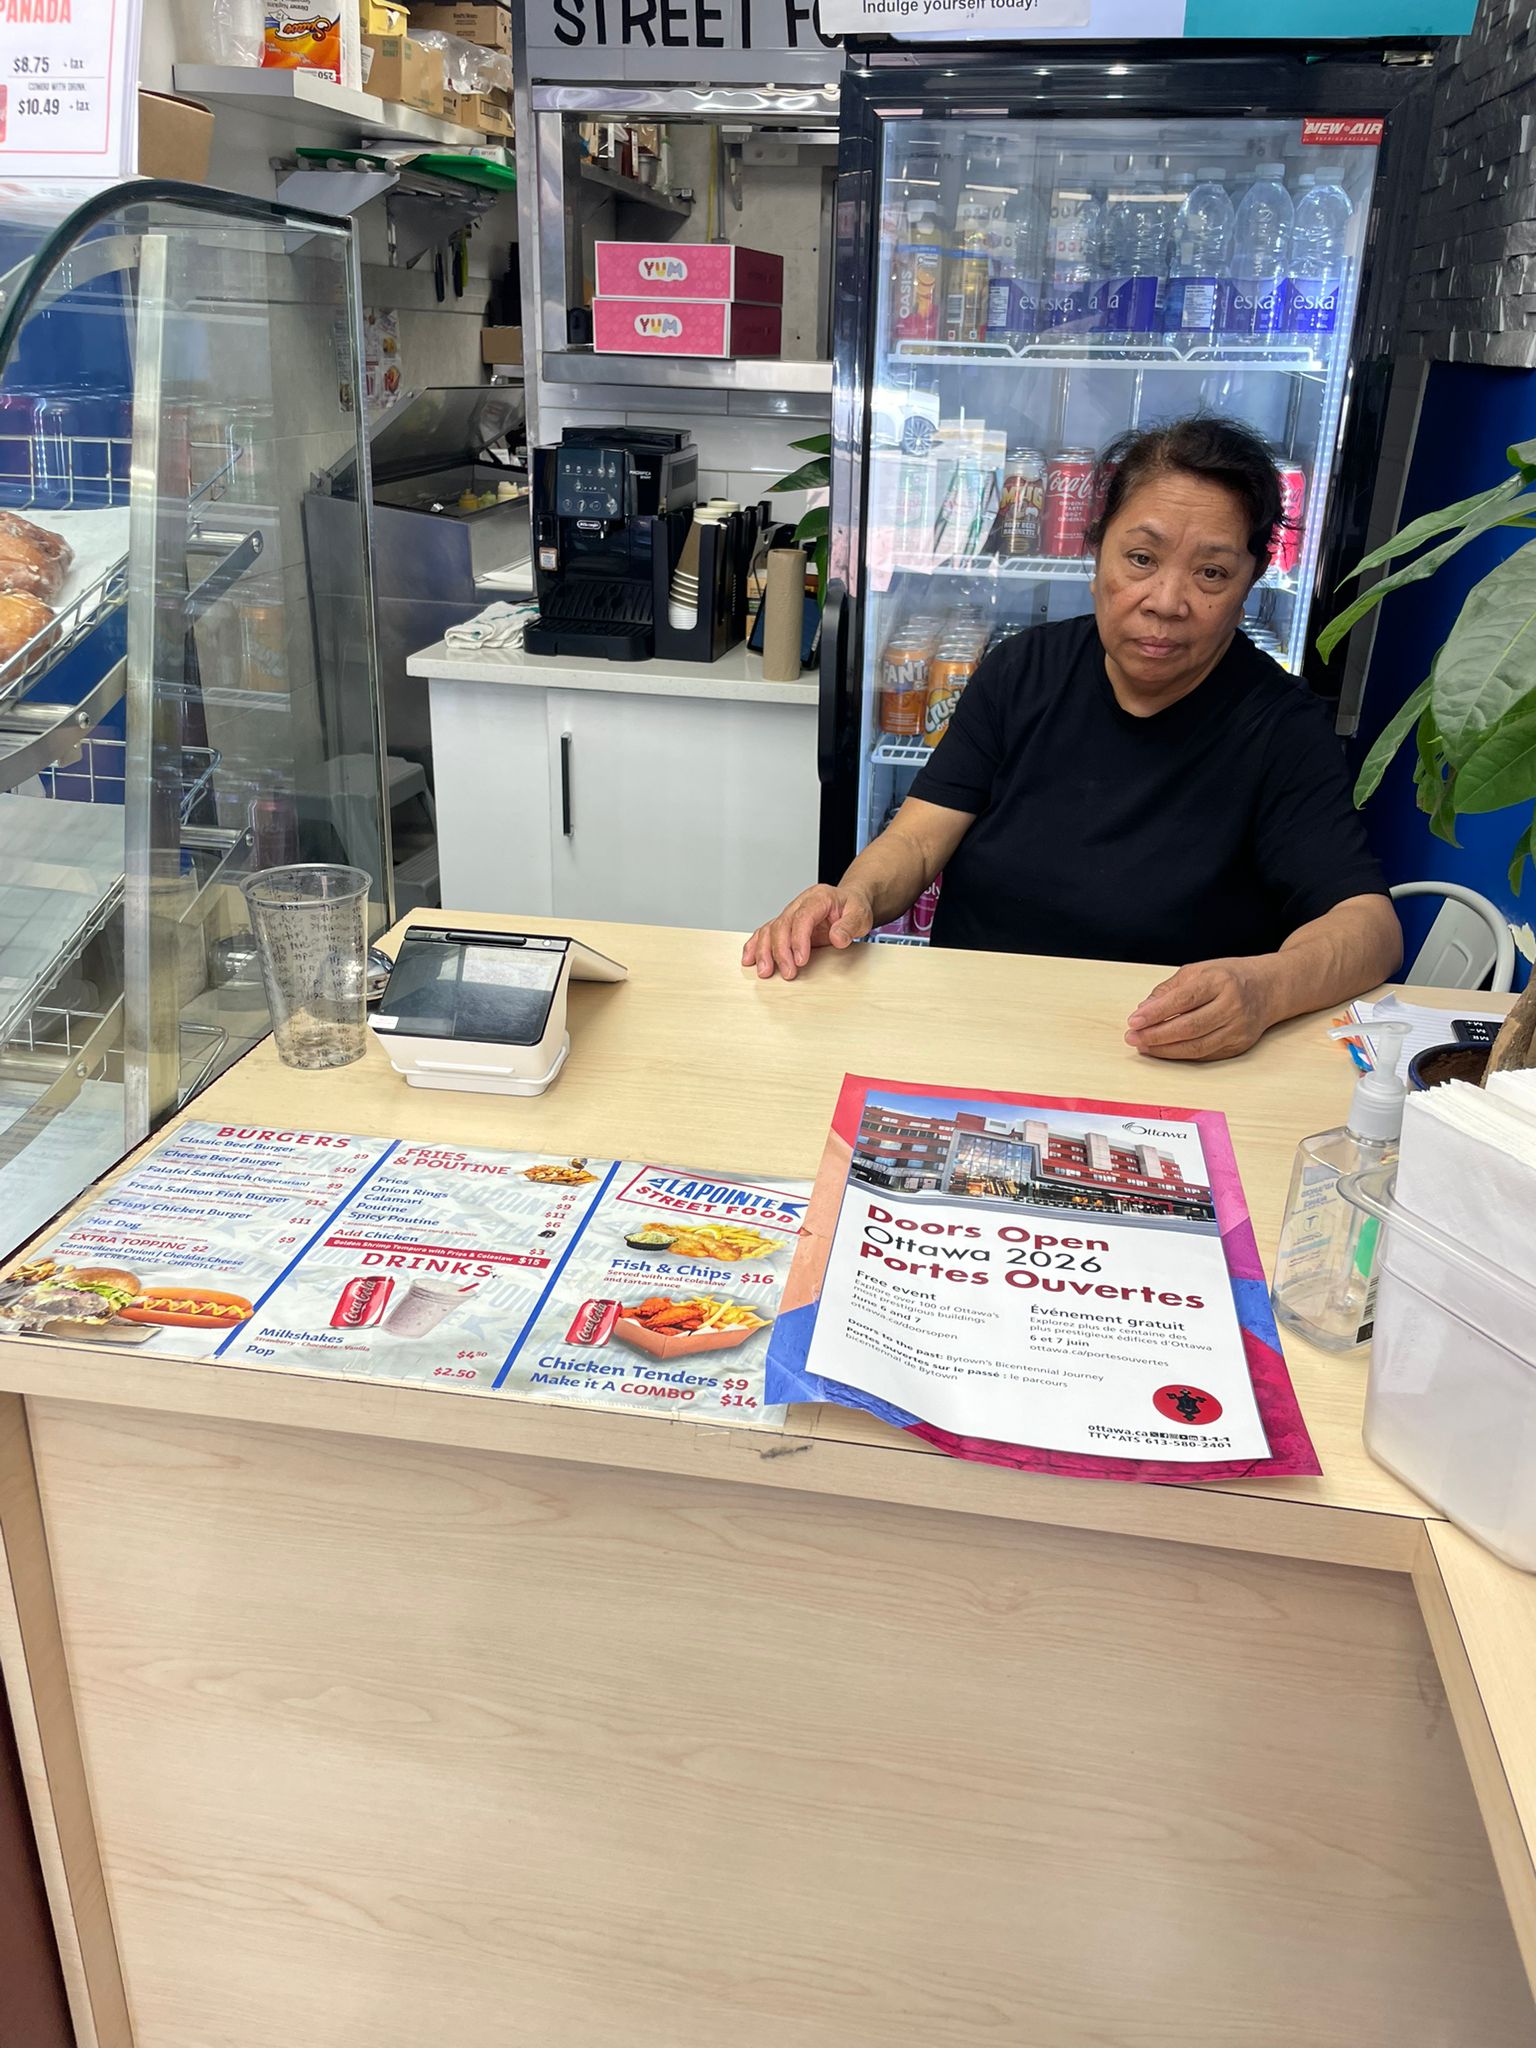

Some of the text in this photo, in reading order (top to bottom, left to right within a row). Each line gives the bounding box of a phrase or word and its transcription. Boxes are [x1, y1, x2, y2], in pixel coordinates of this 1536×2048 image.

[863, 0, 1038, 15] Indulge yourself today!
[554, 0, 751, 49] STREET
[13, 56, 85, 74] $8.75 tax
[318, 71, 334, 80] 250
[18, 98, 90, 116] $10.49 tax
[643, 260, 684, 279] YUM
[900, 268, 913, 319] OASIS
[1234, 293, 1275, 310] eska
[1293, 293, 1335, 310] eska
[639, 317, 679, 335] YUM
[1001, 484, 1044, 509] MUG
[883, 659, 928, 684] FANT
[216, 1126, 352, 1148] BURGERS
[1124, 1122, 1188, 1140] Ottawa
[179, 1135, 222, 1147] Classic
[223, 1141, 254, 1149] Beef
[253, 1143, 296, 1153] Burger
[404, 1148, 467, 1162] FRIES
[164, 1150, 208, 1160] Cheese
[209, 1154, 239, 1163] Beef
[239, 1157, 282, 1167] Burger
[334, 1166, 357, 1174] $10
[410, 1158, 512, 1175] POUTINE
[146, 1165, 190, 1176] Falafel
[190, 1170, 256, 1182] Sandwich
[252, 1176, 311, 1187] (Vegetarian)
[326, 1182, 343, 1190] $9
[377, 1176, 578, 1203] Fries $5
[127, 1181, 163, 1192] Fresh
[164, 1184, 214, 1196] Salmon
[215, 1189, 243, 1199] Fish
[244, 1192, 290, 1204] Burger
[304, 1198, 328, 1208] $12
[363, 1194, 567, 1219] Calamari $11
[370, 1185, 573, 1212] Onion Rings $9
[635, 1186, 795, 1225] STREET FOOD
[664, 1178, 779, 1210] LAPOINTE
[107, 1198, 151, 1211] Crispy
[152, 1203, 206, 1215] Chicken
[206, 1208, 253, 1220] Burger
[289, 1216, 312, 1225] $11
[347, 1211, 387, 1223] Spicy
[386, 1214, 440, 1227] Poutine
[355, 1202, 561, 1230] Poutine $6
[87, 1216, 296, 1244] Hot Dog $9
[867, 1204, 1109, 1252] Doors Open
[68, 1232, 118, 1244] EXTRA
[120, 1237, 188, 1251] TOPPING
[191, 1244, 209, 1253] $2
[333, 1228, 546, 1257] Add Chicken $3
[392, 1244, 542, 1266] Tempura $15
[863, 1225, 1103, 1274] Ottawa 2026
[124, 1247, 245, 1266] Onion Cheddar Cheese
[360, 1252, 493, 1278] DRINKS
[603, 1276, 681, 1290] and tartar sauce
[607, 1269, 727, 1288] Served with coleslaw
[610, 1258, 775, 1285] Fish & Chips $16
[860, 1241, 1206, 1310] Portes Ouvertes
[856, 1269, 937, 1301] Free event
[851, 1293, 912, 1321] June and
[853, 1286, 987, 1325] most prestigious buildings
[854, 1278, 1000, 1319] Explore 100 Ottawa's
[850, 1301, 959, 1340] ottawa.ca/doorsopen
[1029, 1316, 1188, 1341] Explorez plus centaine des
[1030, 1304, 1186, 1332] Événement gratuit
[253, 1336, 296, 1346] Strawberry
[258, 1327, 345, 1344] Milkshakes
[1029, 1325, 1213, 1351] plus prestigieux édifices d'Ottawa
[1065, 1338, 1090, 1348] juin
[245, 1344, 477, 1379] Pop $2.50
[846, 1326, 1069, 1388] Portes ouvertes passé parcours
[847, 1318, 1104, 1382] Doors the past: Bytown's Bicentennial Journey
[1029, 1344, 1170, 1367] ottawa.ca/portesouvertes
[537, 1356, 750, 1391] Chicken Tenders $9
[919, 1365, 959, 1381] Bytown
[530, 1372, 758, 1409] Make it A COMBO $14
[1087, 1424, 1149, 1437] ottawa.ca
[1088, 1431, 1232, 1448] TTY ATS 613-580-2401
